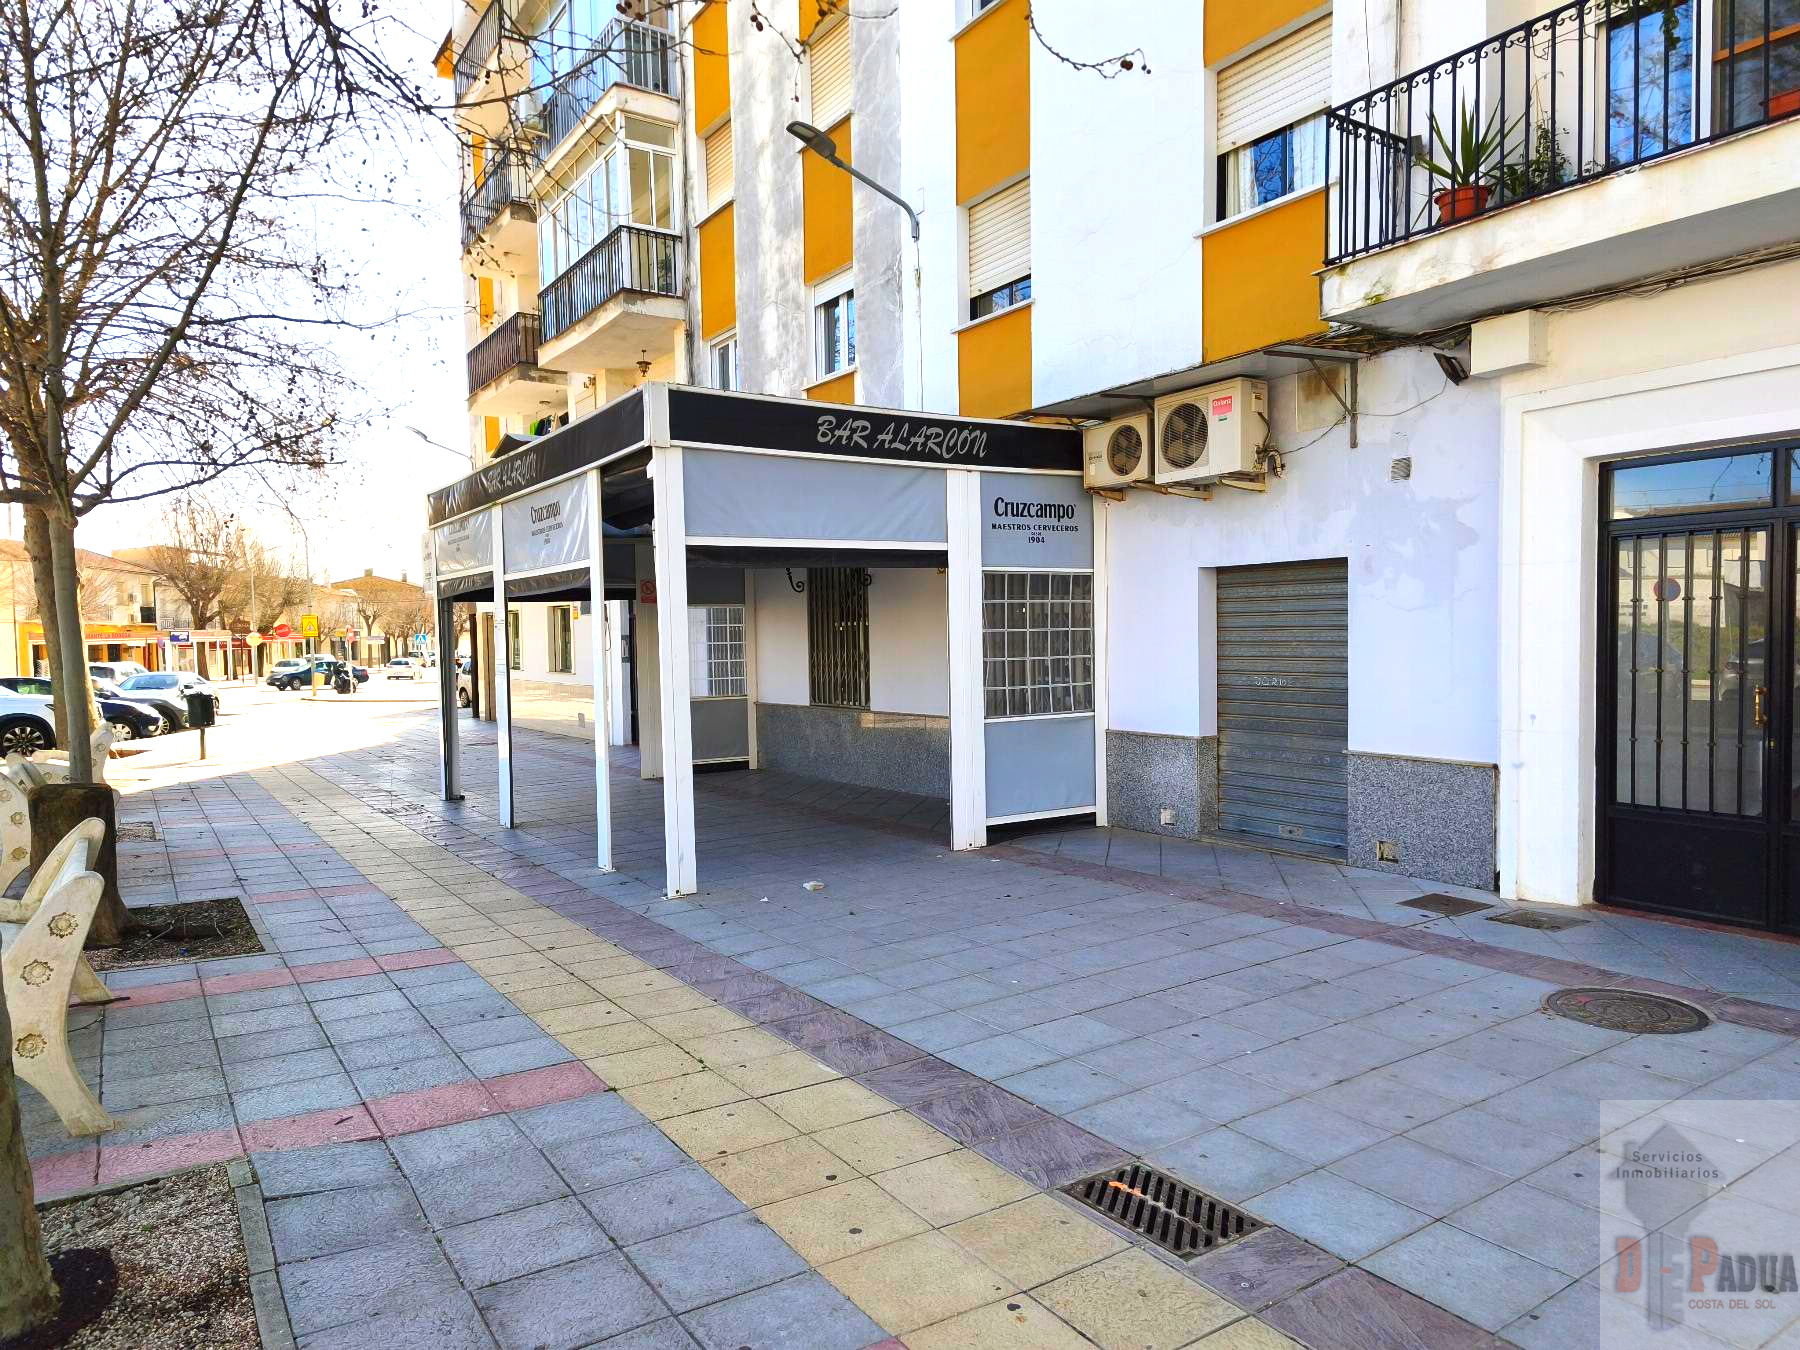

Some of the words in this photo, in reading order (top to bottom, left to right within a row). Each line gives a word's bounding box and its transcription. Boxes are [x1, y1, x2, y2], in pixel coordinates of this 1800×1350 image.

[817, 415, 872, 449] BAR
[873, 421, 988, 459] ALARCÓN
[994, 496, 1075, 523] Cruzcampo
[991, 522, 1032, 531] MAESTROS
[1033, 523, 1079, 532] CERVECEROS
[1028, 536, 1046, 544] 1904
